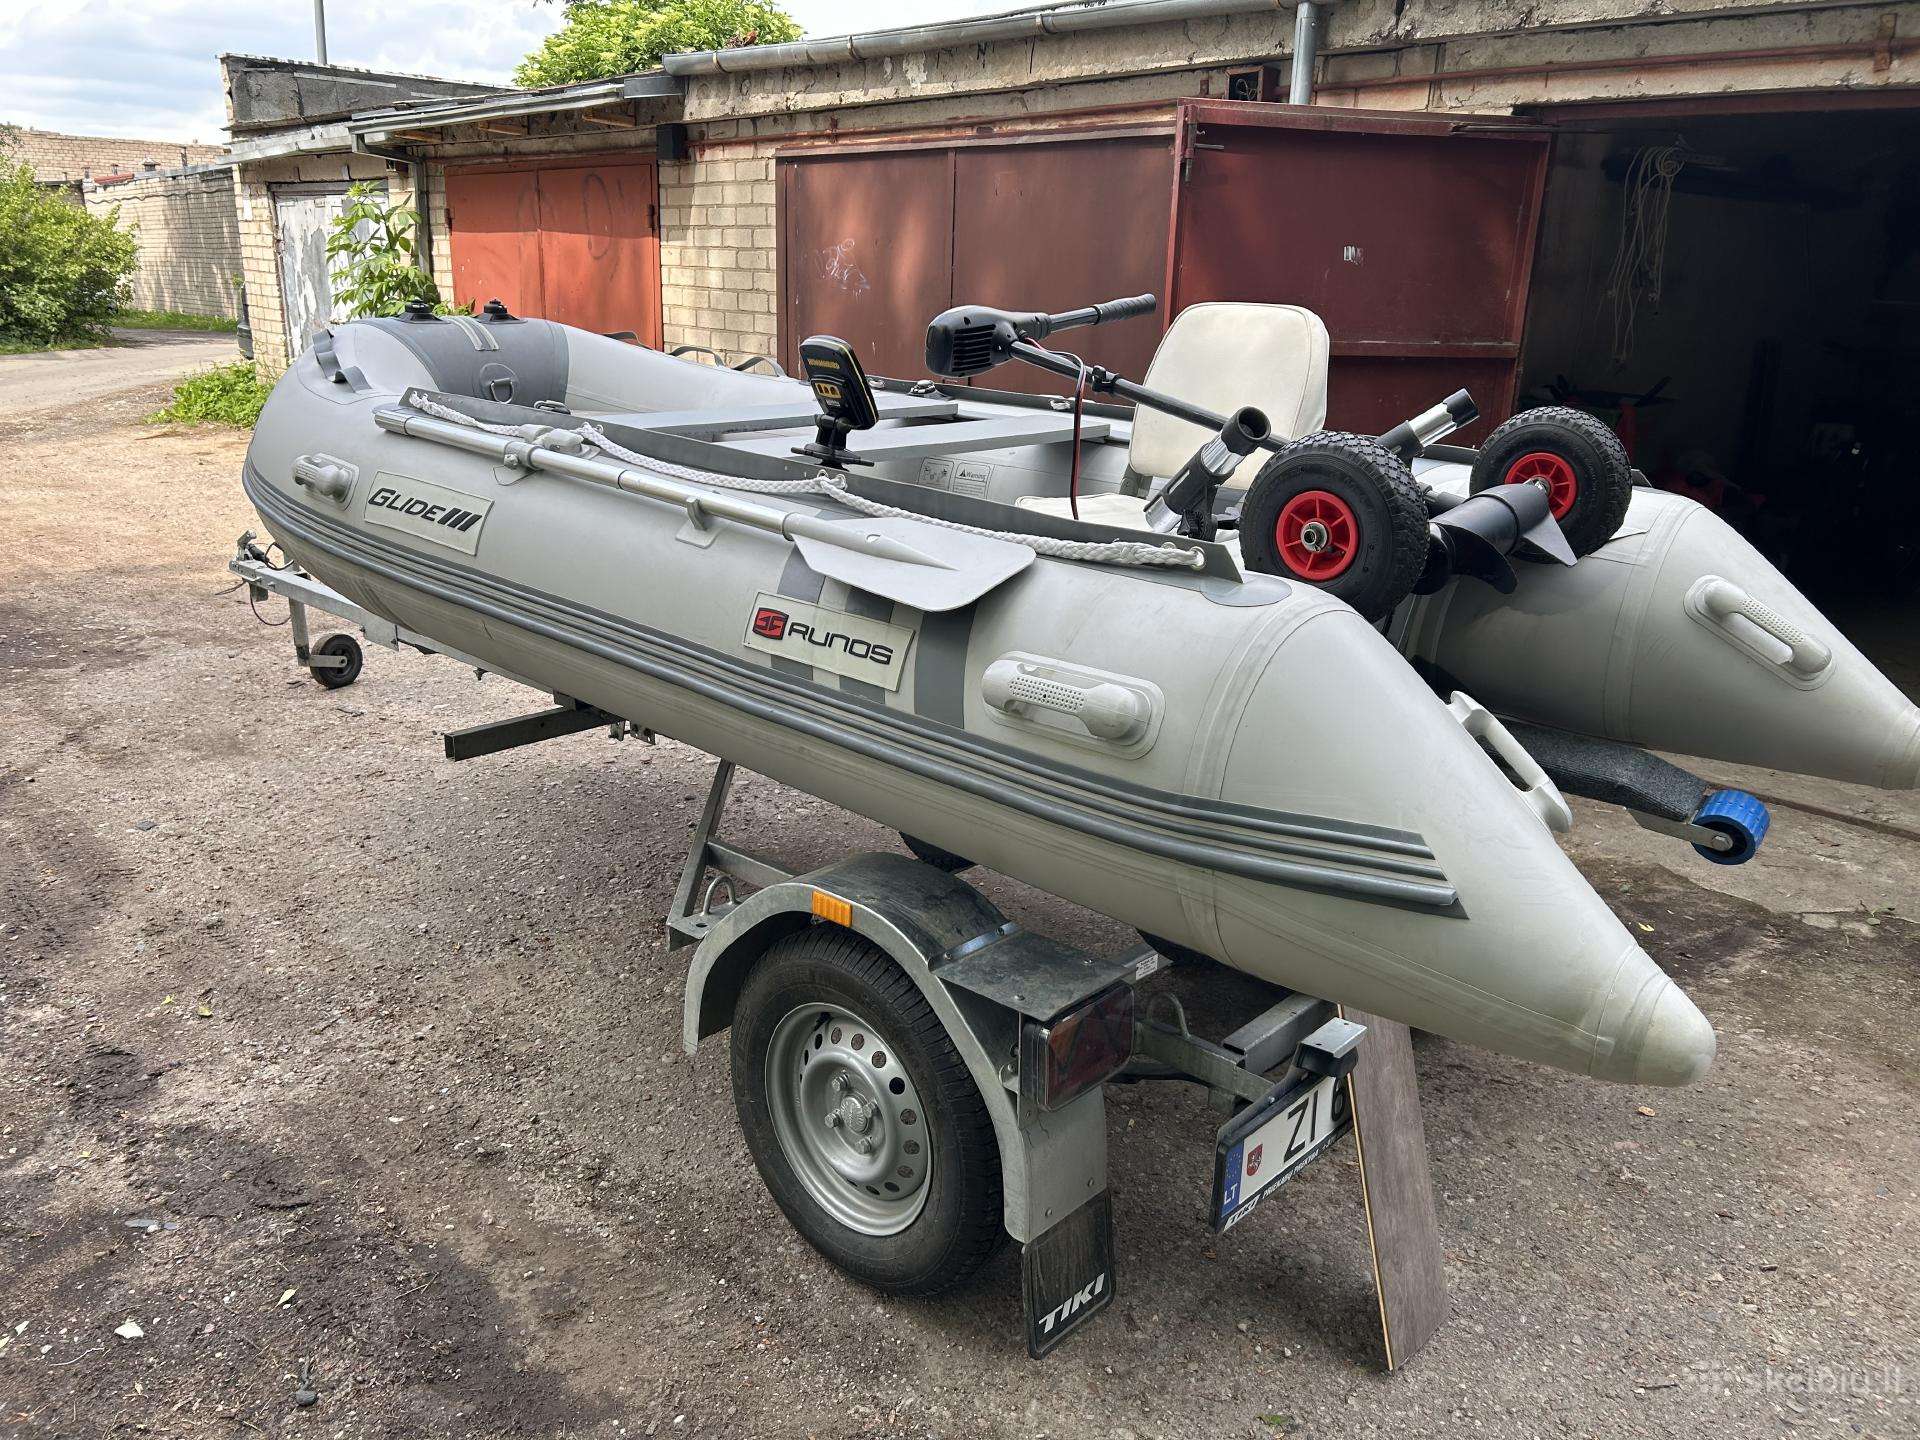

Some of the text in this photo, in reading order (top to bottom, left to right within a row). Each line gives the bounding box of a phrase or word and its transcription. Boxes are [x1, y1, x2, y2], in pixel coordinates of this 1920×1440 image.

[788, 621, 893, 665] RUNOS
[1223, 1182, 1238, 1205] LT
[1038, 1272, 1105, 1334] TIKI
